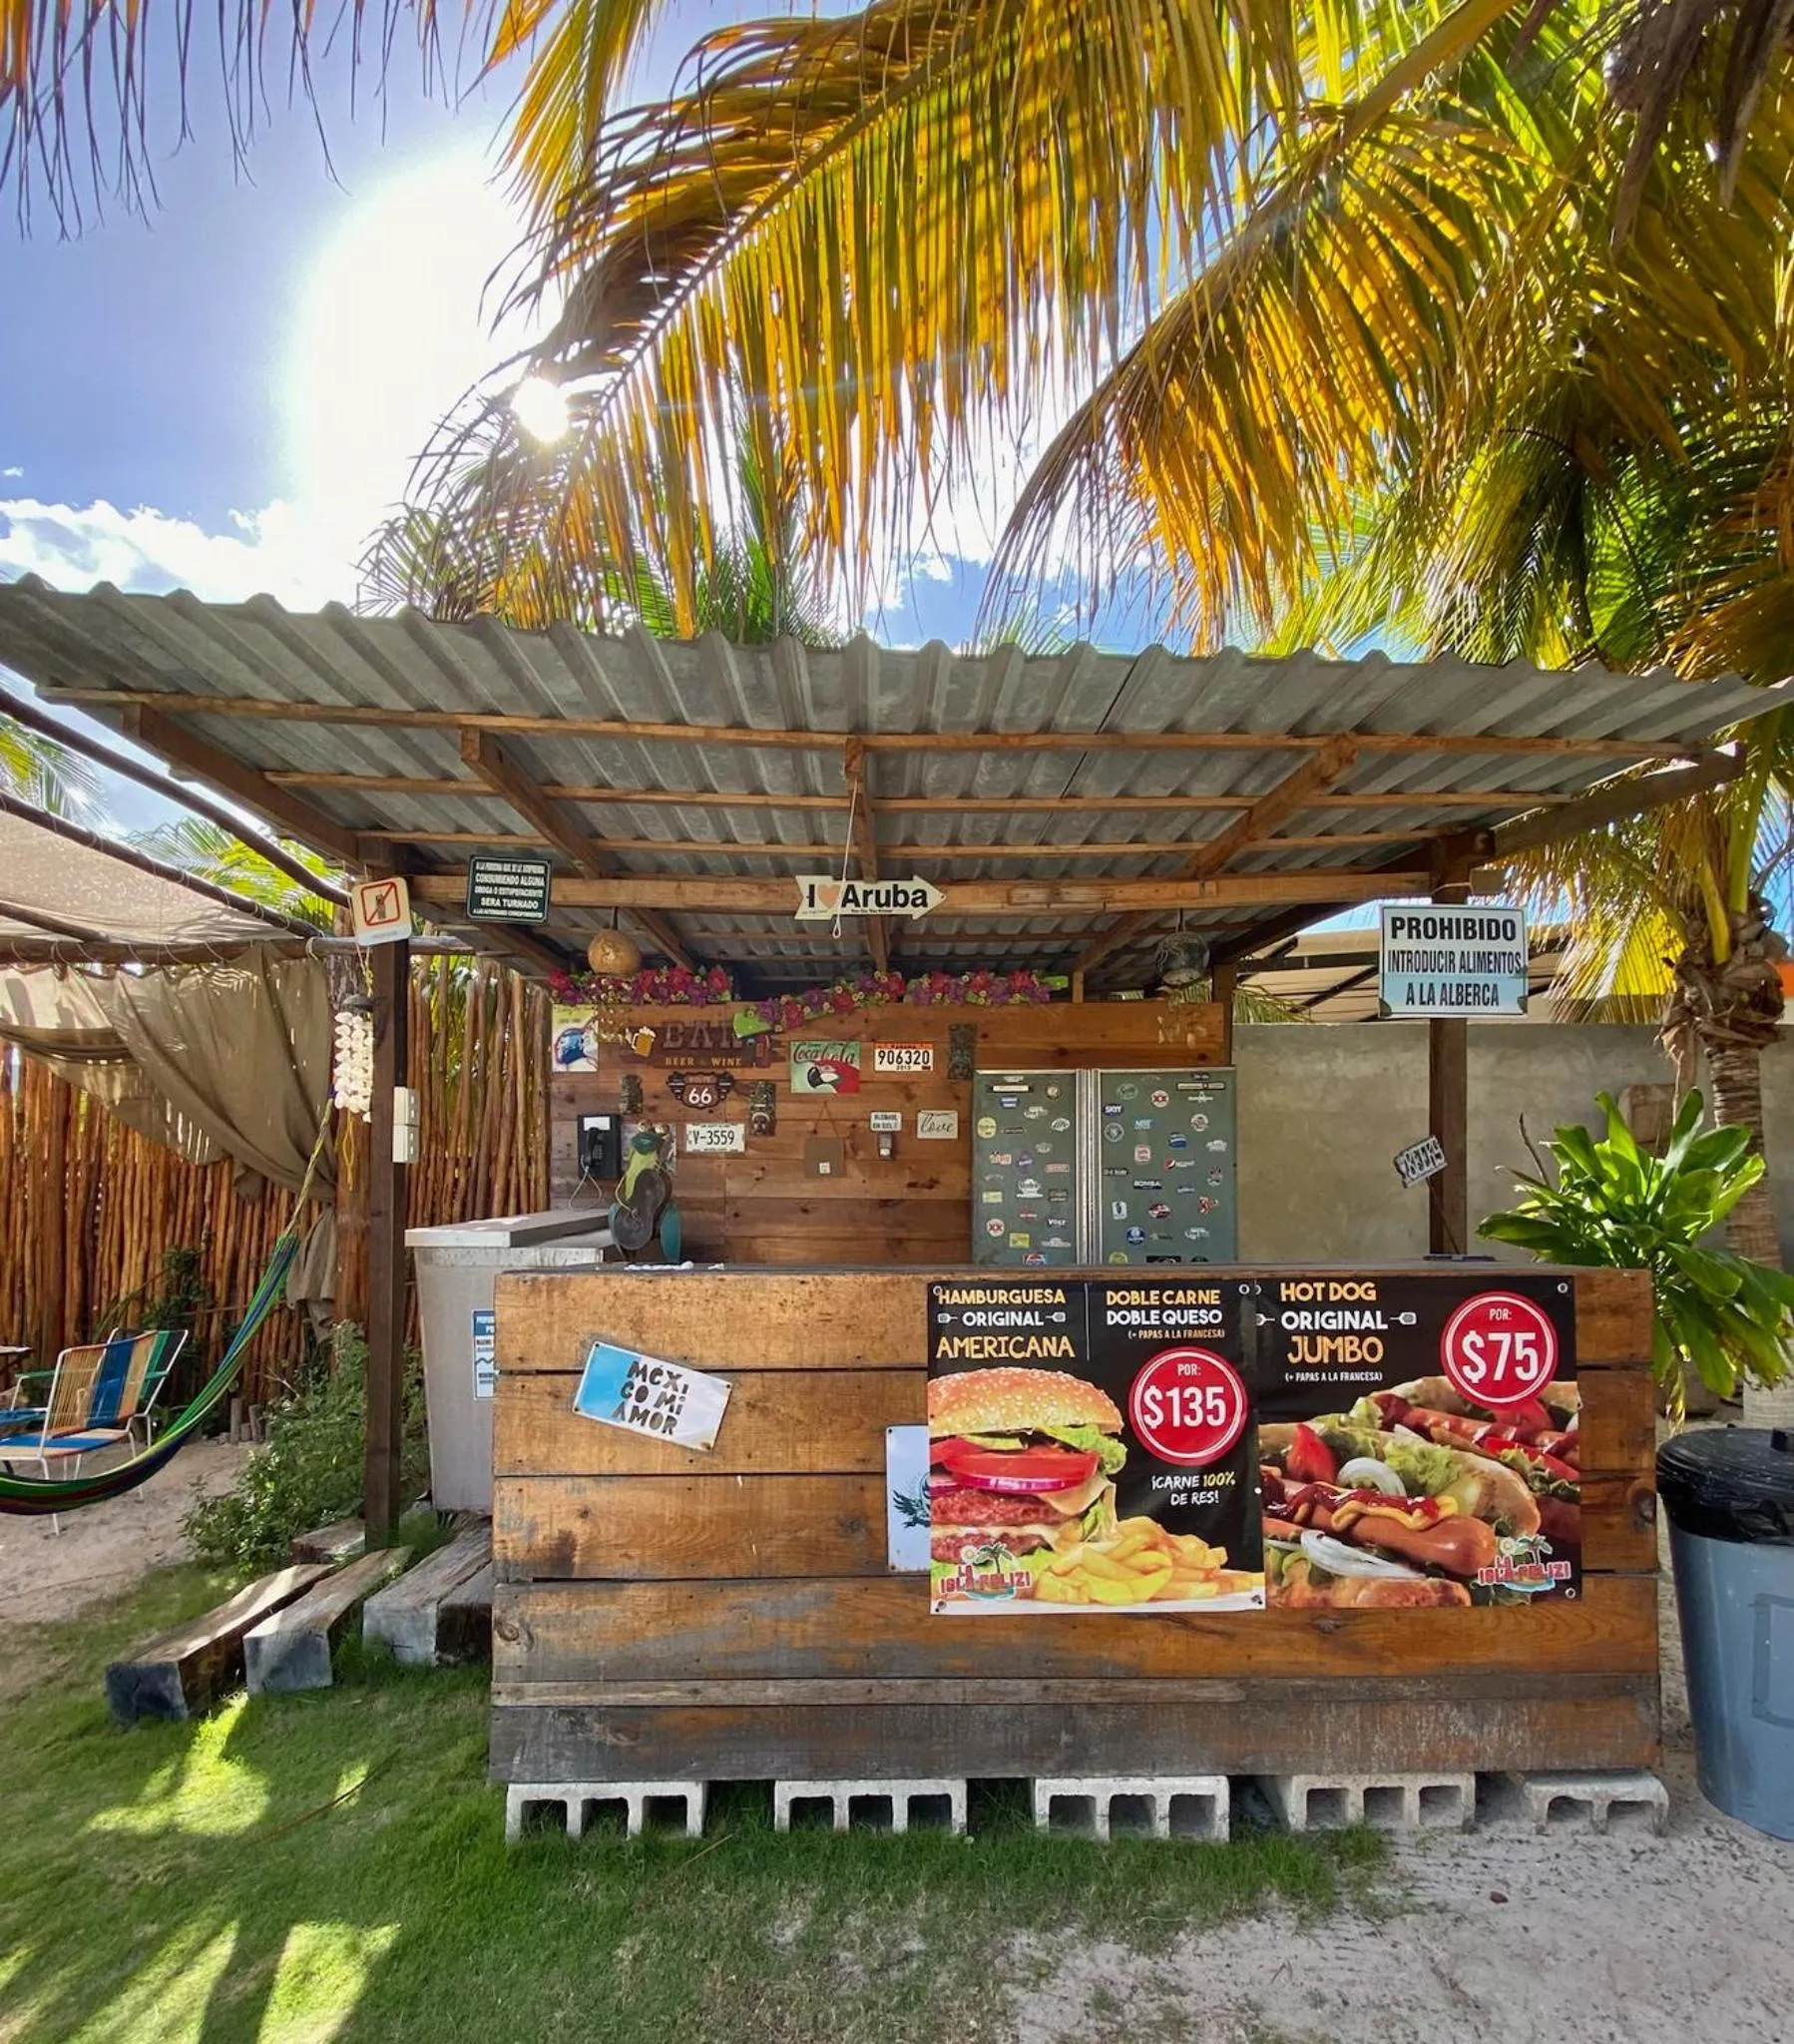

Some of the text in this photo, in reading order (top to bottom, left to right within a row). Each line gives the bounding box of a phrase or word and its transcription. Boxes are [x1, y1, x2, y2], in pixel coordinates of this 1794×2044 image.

[808, 884, 928, 908] I Aruba
[1391, 916, 1516, 941] PROHIBIDO
[1388, 950, 1523, 975] INTRODUCIR ALIMENTOS
[1406, 982, 1500, 1006] A LA ALBERCA
[665, 1057, 694, 1066] BEER
[711, 1057, 742, 1067] WINE
[878, 1050, 930, 1065] 906320
[688, 1088, 711, 1104] 66
[938, 1288, 1066, 1305] HAMBURGUESA
[1107, 1288, 1221, 1306] DOBLE CARNE
[1280, 1282, 1377, 1302] HOT DOG
[962, 1310, 1045, 1327] ORIGINAL
[1107, 1308, 1223, 1325] DOBLE QUESO
[1281, 1310, 1389, 1330] ORIGINAL
[1490, 1308, 1513, 1321] POR:
[1138, 1329, 1163, 1338] PAPAS
[1163, 1329, 1169, 1338] A
[1171, 1329, 1181, 1338] LA
[1183, 1328, 1225, 1339] FRANCESA)
[936, 1335, 1076, 1360] AMERICANA
[1287, 1335, 1385, 1364] JUMBO
[1462, 1329, 1539, 1384] $75
[1177, 1363, 1202, 1376] POR:
[1295, 1371, 1319, 1381] PAPAS
[1320, 1372, 1327, 1381] A
[1328, 1372, 1338, 1381] LA
[1340, 1371, 1383, 1381] FRANCESA)
[621, 1380, 650, 1403] CO
[1143, 1384, 1227, 1430] $135
[611, 1400, 678, 1435] AMOR
[1203, 1471, 1236, 1487] 100%
[1170, 1490, 1219, 1506] DE RES!
